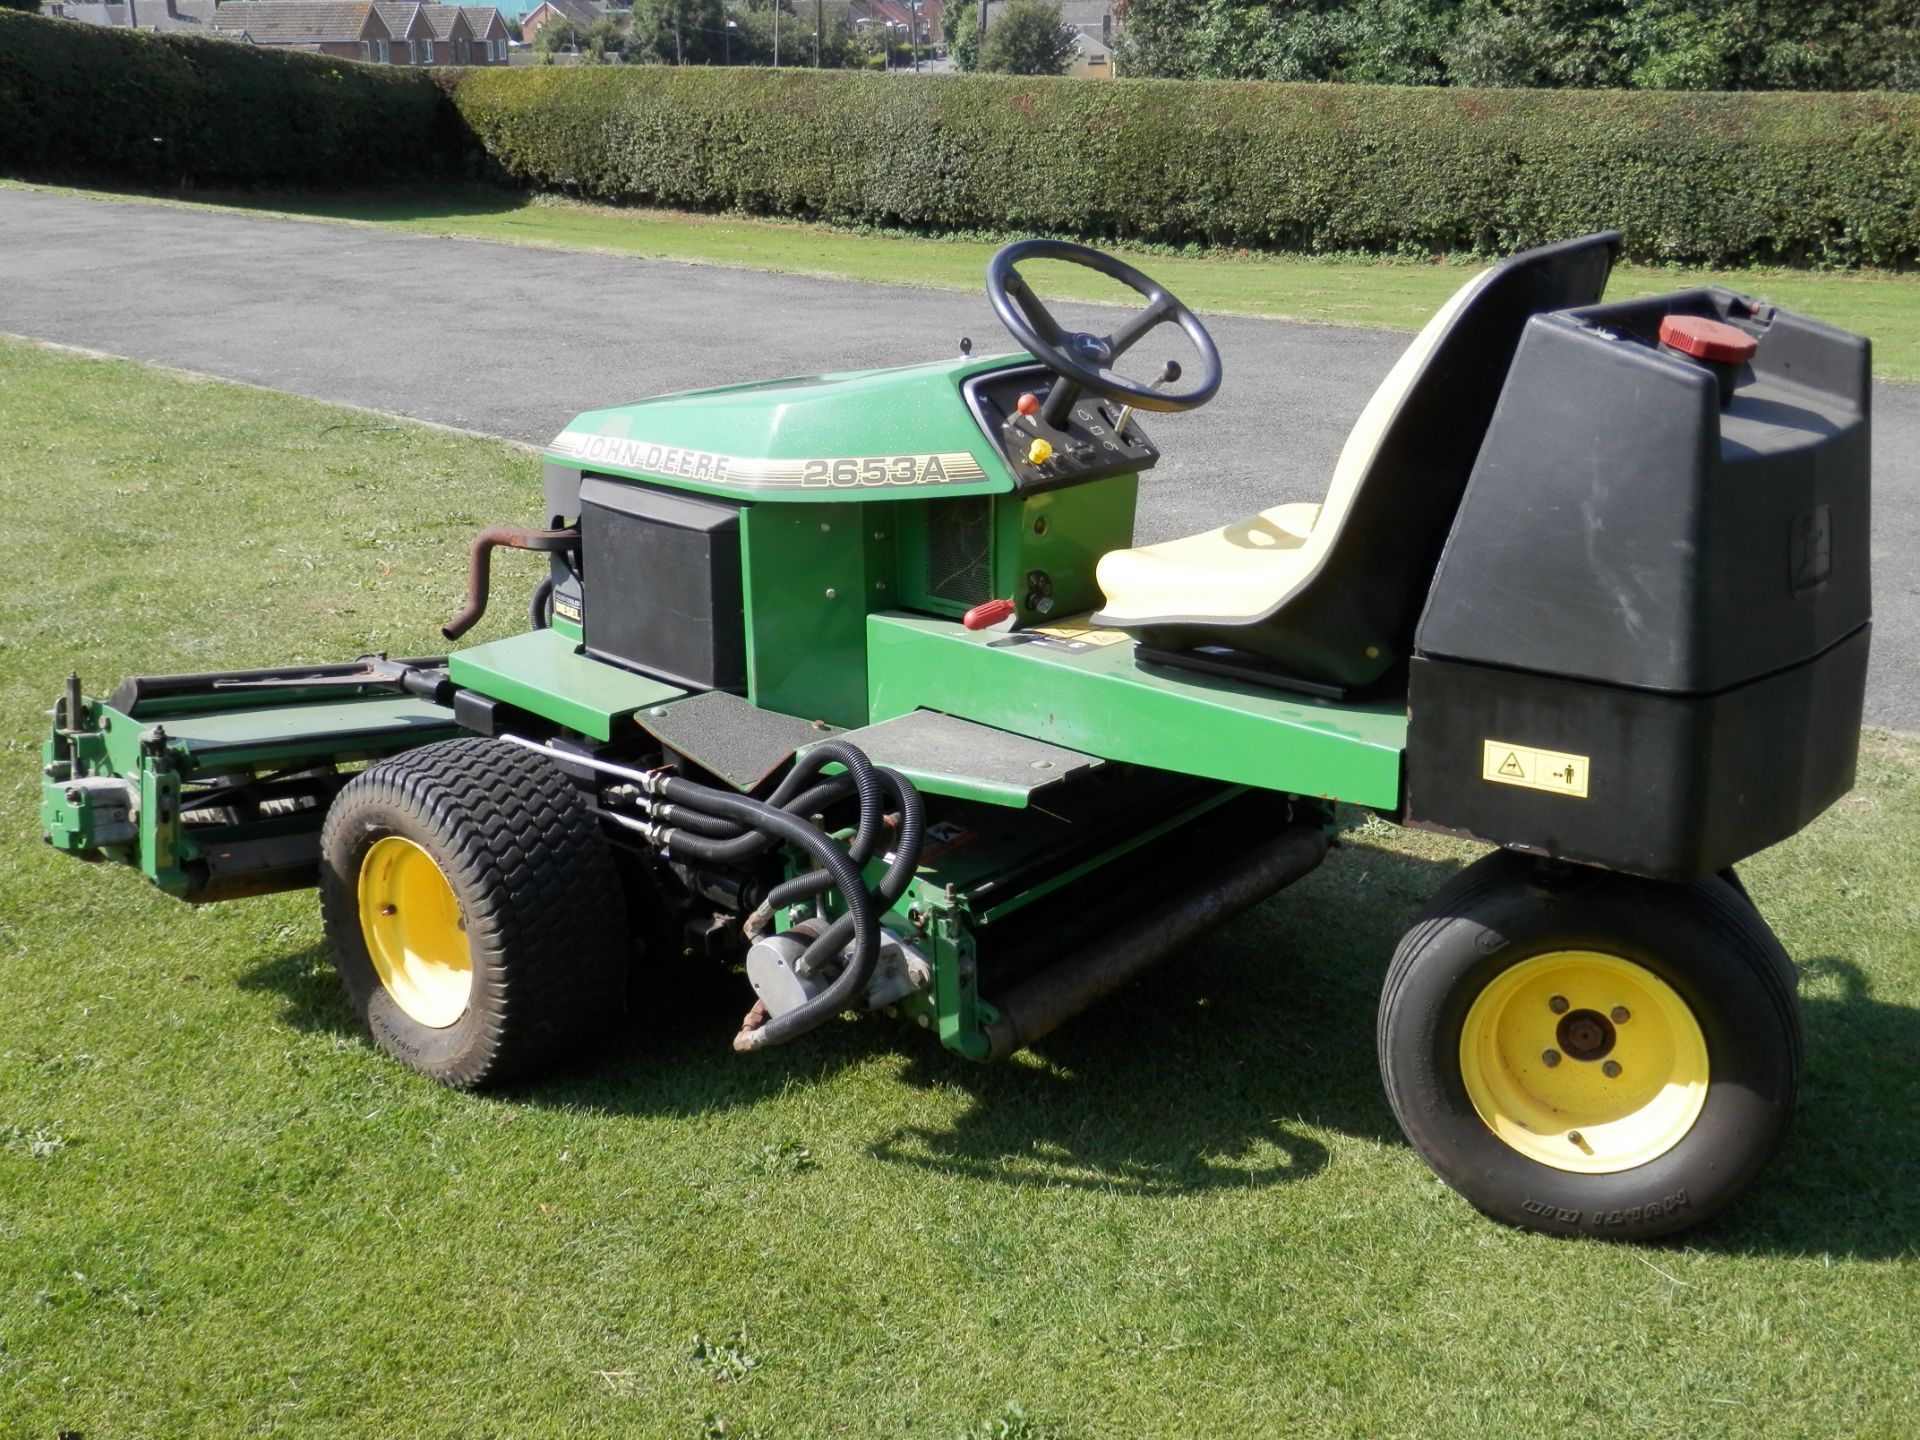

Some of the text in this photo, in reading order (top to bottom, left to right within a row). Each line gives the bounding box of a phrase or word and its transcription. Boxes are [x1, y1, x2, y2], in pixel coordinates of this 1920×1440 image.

[574, 437, 731, 482] JOHN DEERE
[801, 455, 950, 488] 2653A
